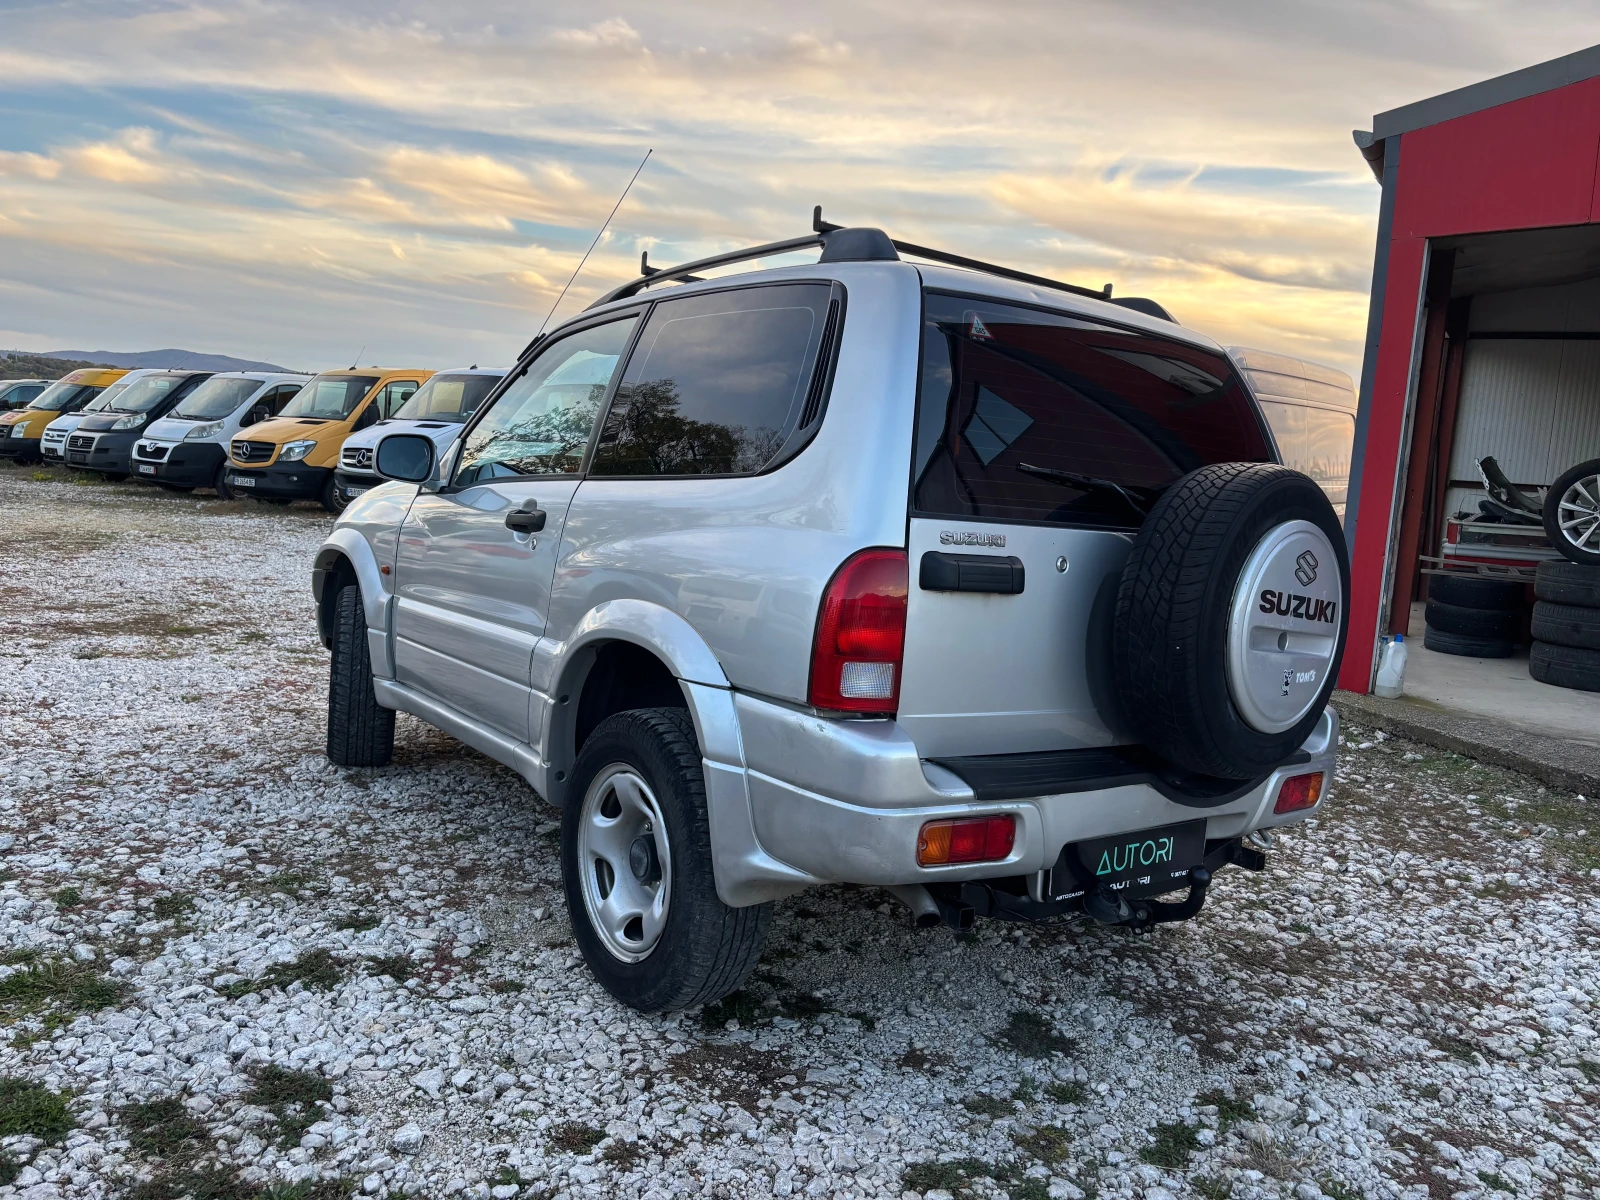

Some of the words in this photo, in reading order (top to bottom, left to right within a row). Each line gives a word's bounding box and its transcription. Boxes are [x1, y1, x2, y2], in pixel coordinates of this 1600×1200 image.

[940, 530, 1006, 548] SUZUKI
[1259, 589, 1337, 624] SUZUKI
[1096, 836, 1174, 876] AUTORI
[1109, 875, 1151, 890] AUTRI
